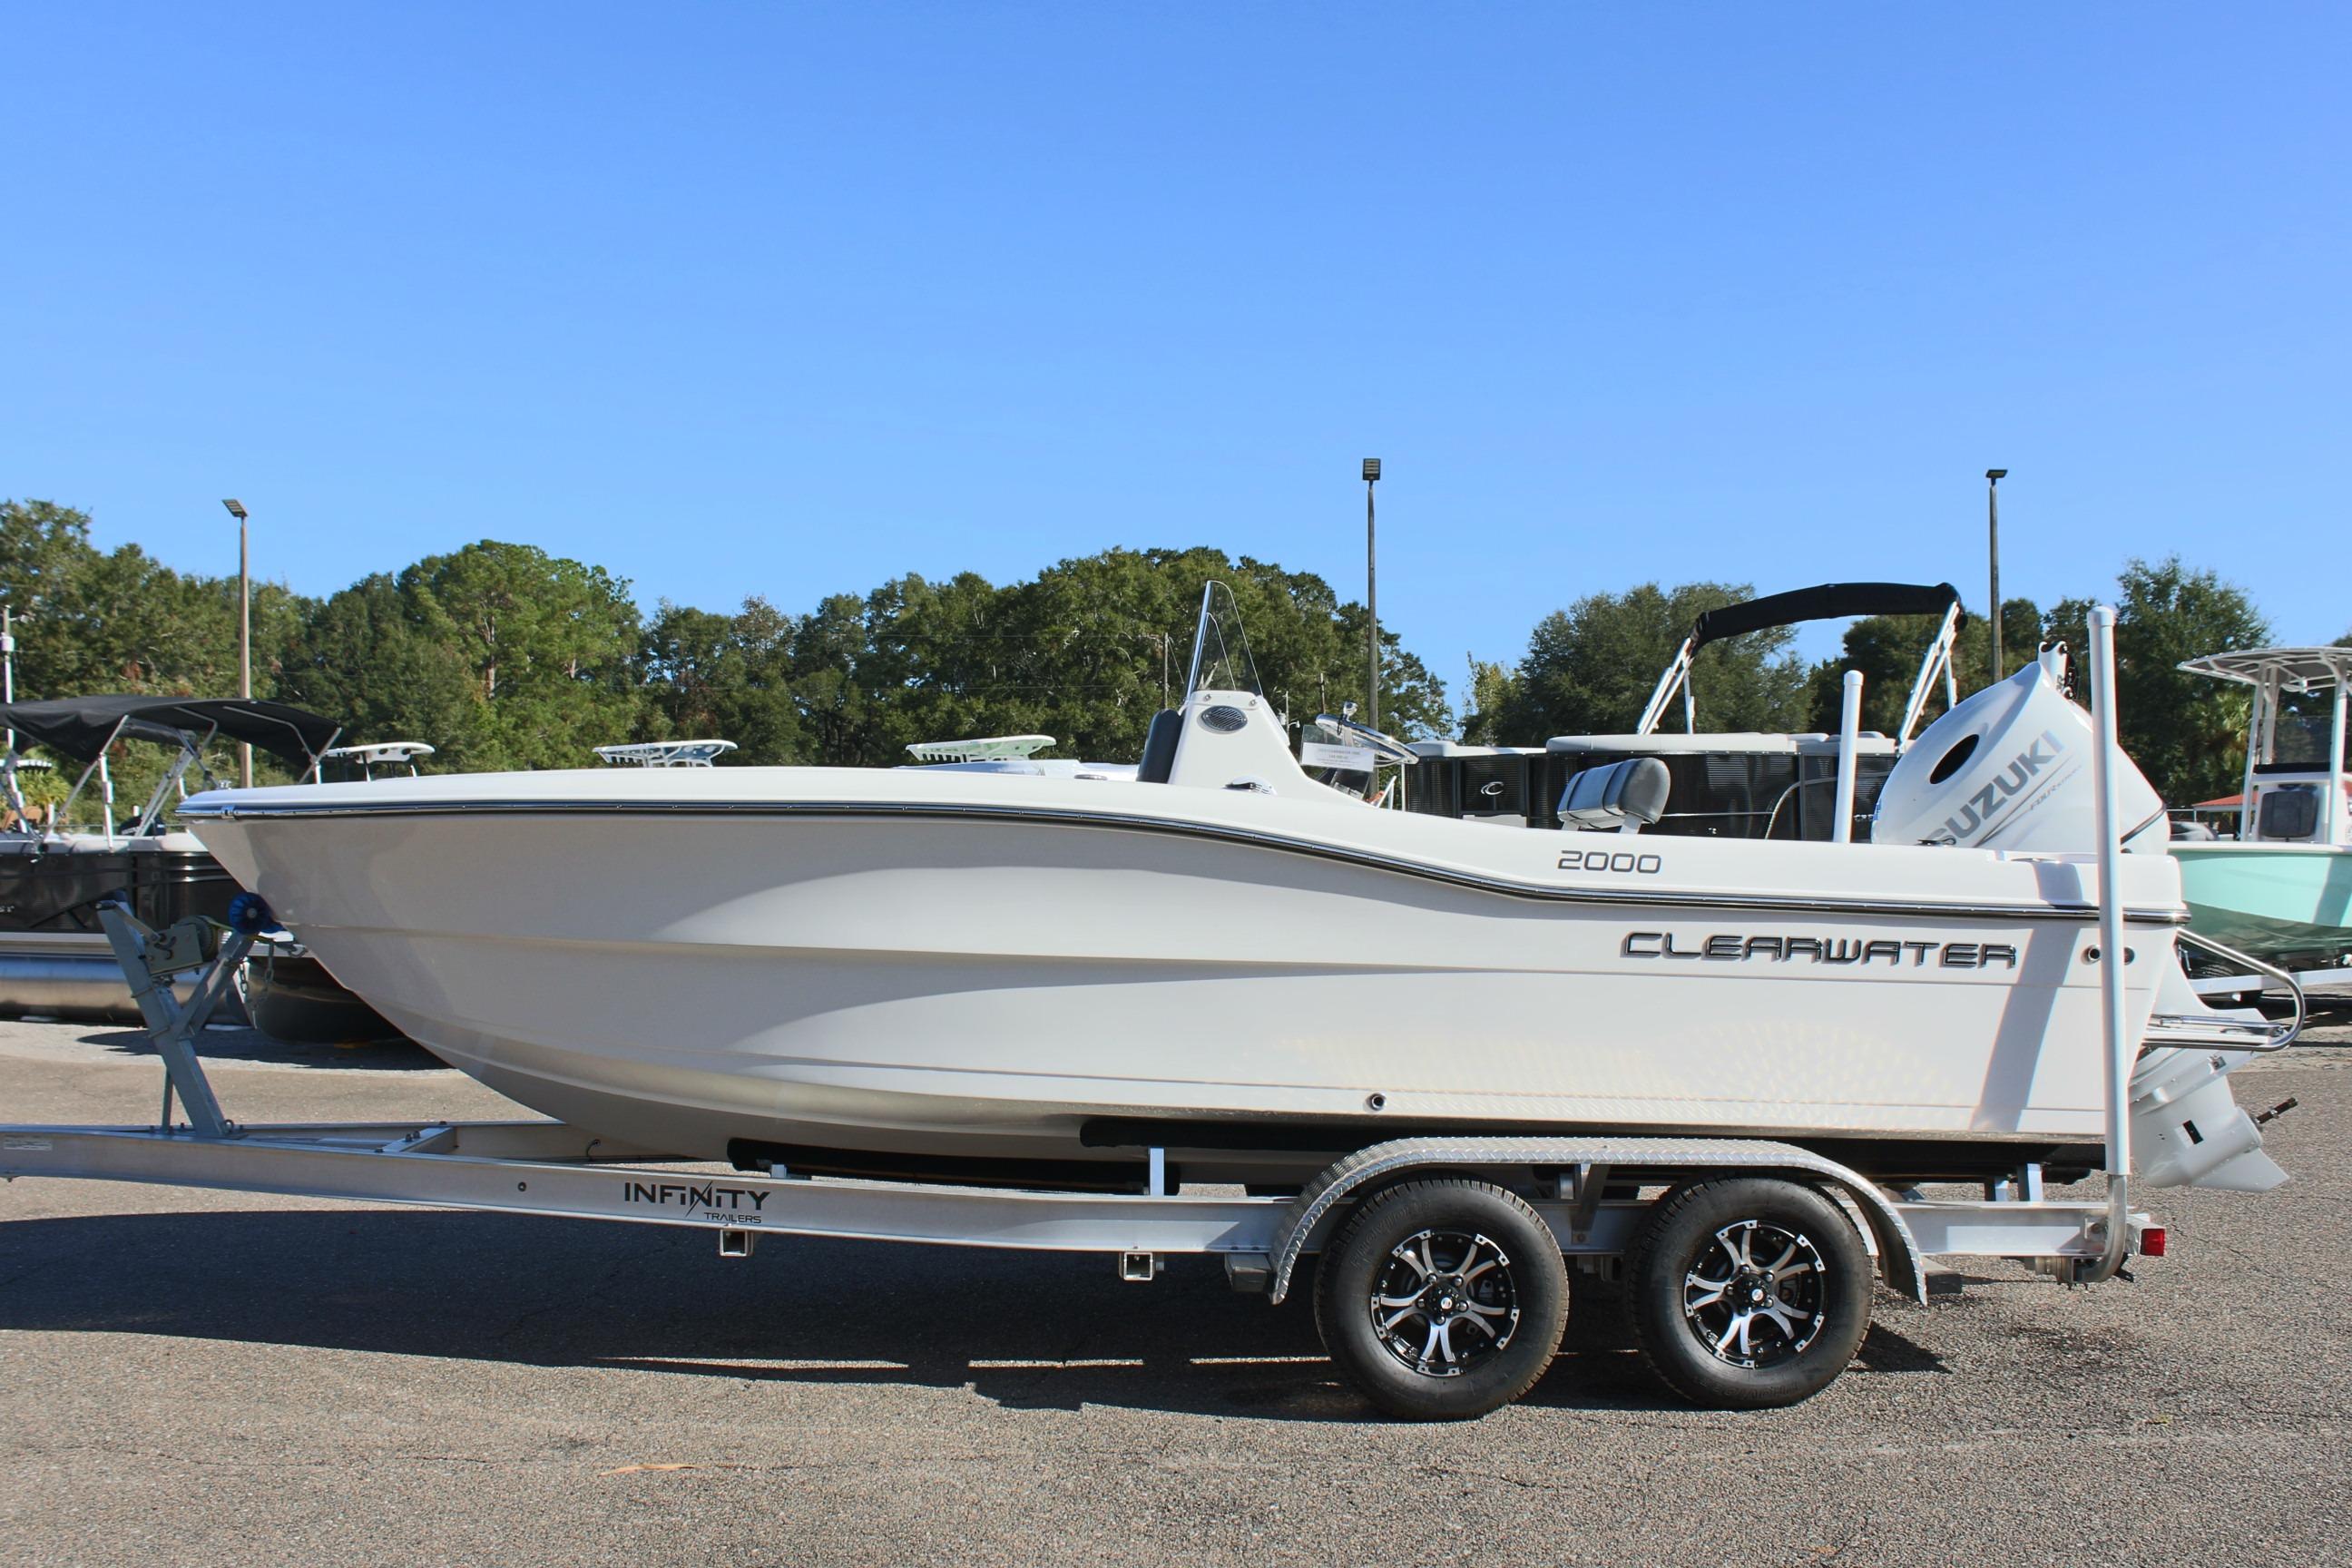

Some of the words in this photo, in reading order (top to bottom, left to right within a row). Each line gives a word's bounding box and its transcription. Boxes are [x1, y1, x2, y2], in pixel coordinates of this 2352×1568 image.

[1925, 730, 2066, 846] SUZUKI
[1557, 849, 1661, 874] 2000
[1622, 931, 2017, 969] CLEARWATER
[624, 1181, 770, 1211] INFINITY
[703, 1211, 762, 1224] TRAILERS
